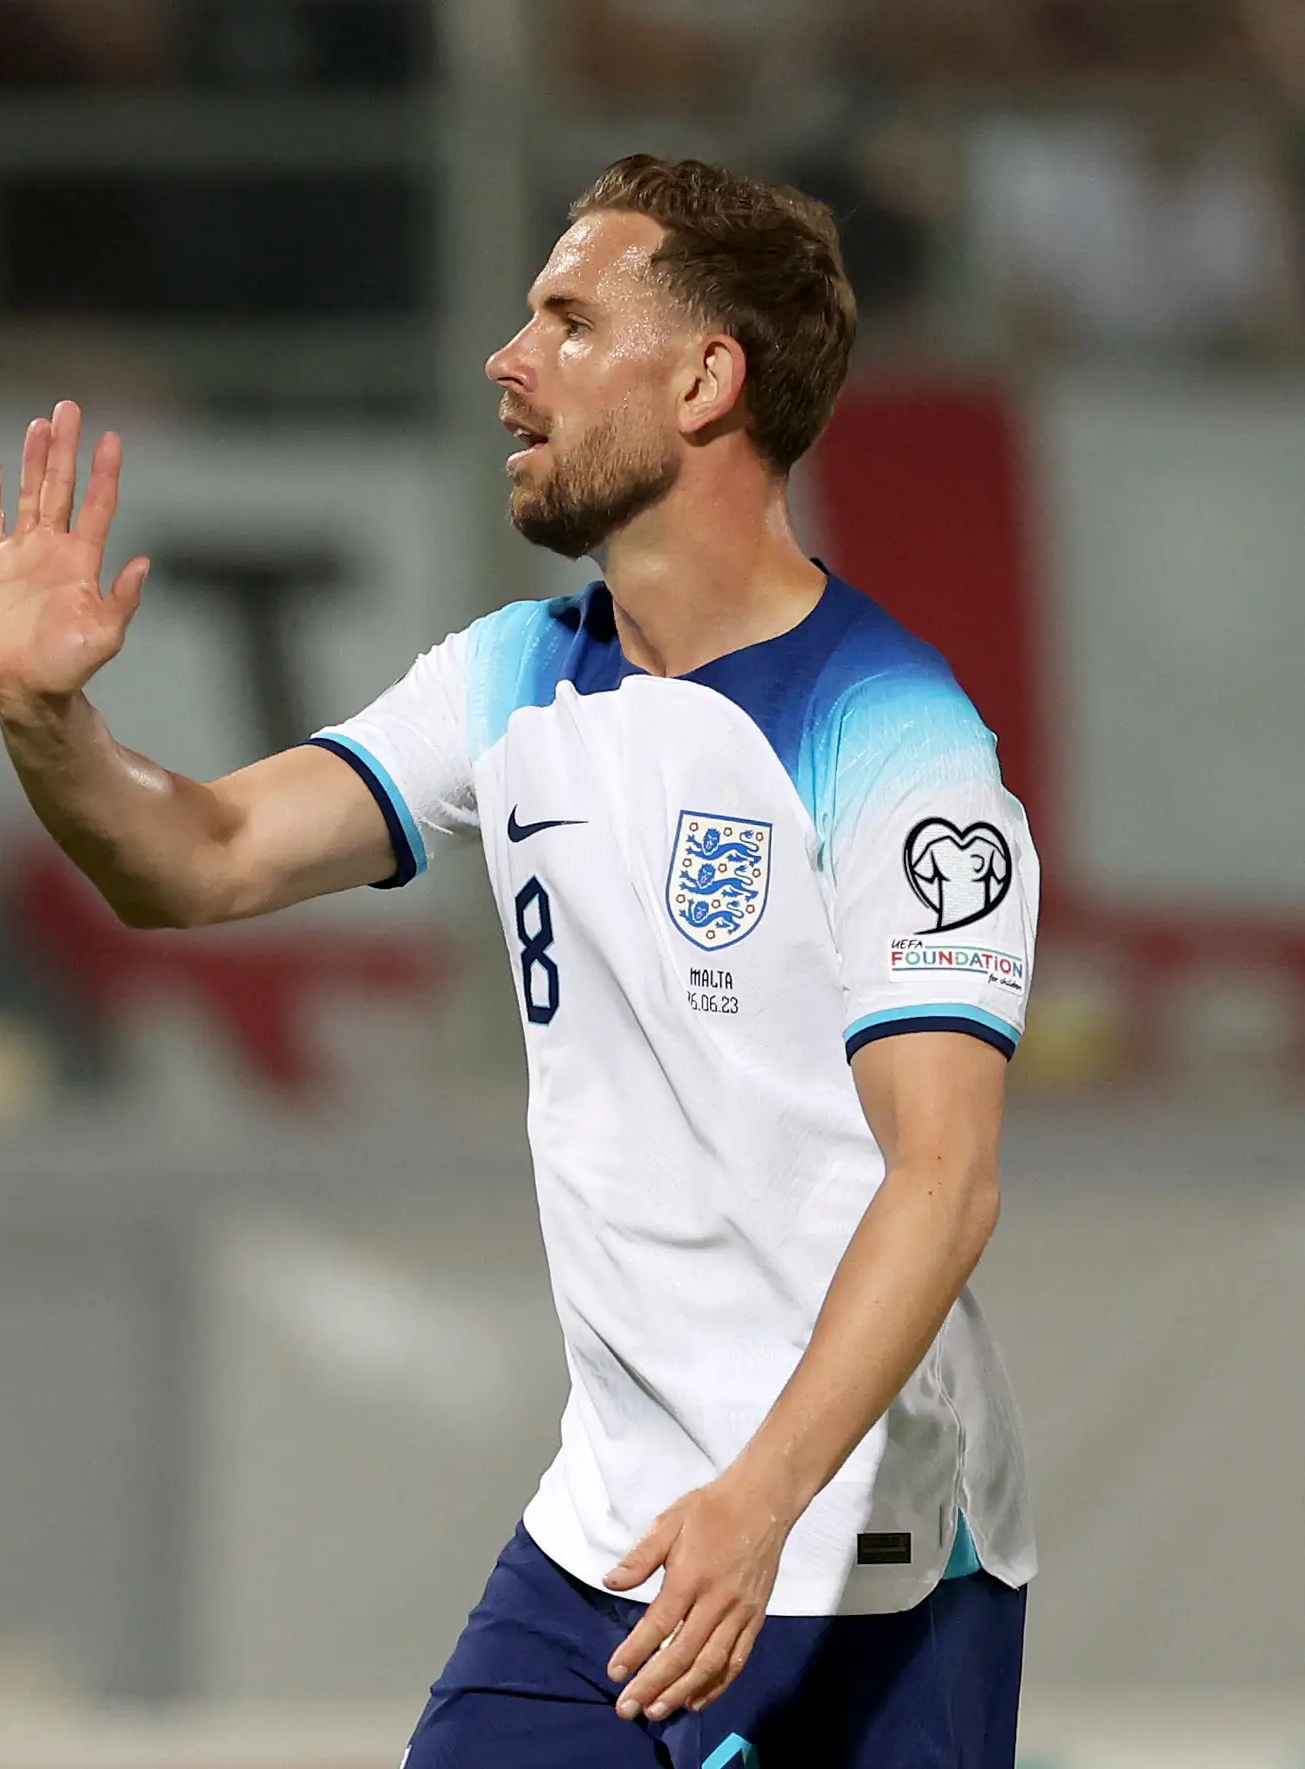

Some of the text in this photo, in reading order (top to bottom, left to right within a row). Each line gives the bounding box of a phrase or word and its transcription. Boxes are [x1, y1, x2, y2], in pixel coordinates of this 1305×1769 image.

[515, 874, 560, 1026] 8
[891, 939, 924, 949] UEFA
[891, 951, 1022, 978] FOUNDATION
[690, 967, 733, 989] MALTA
